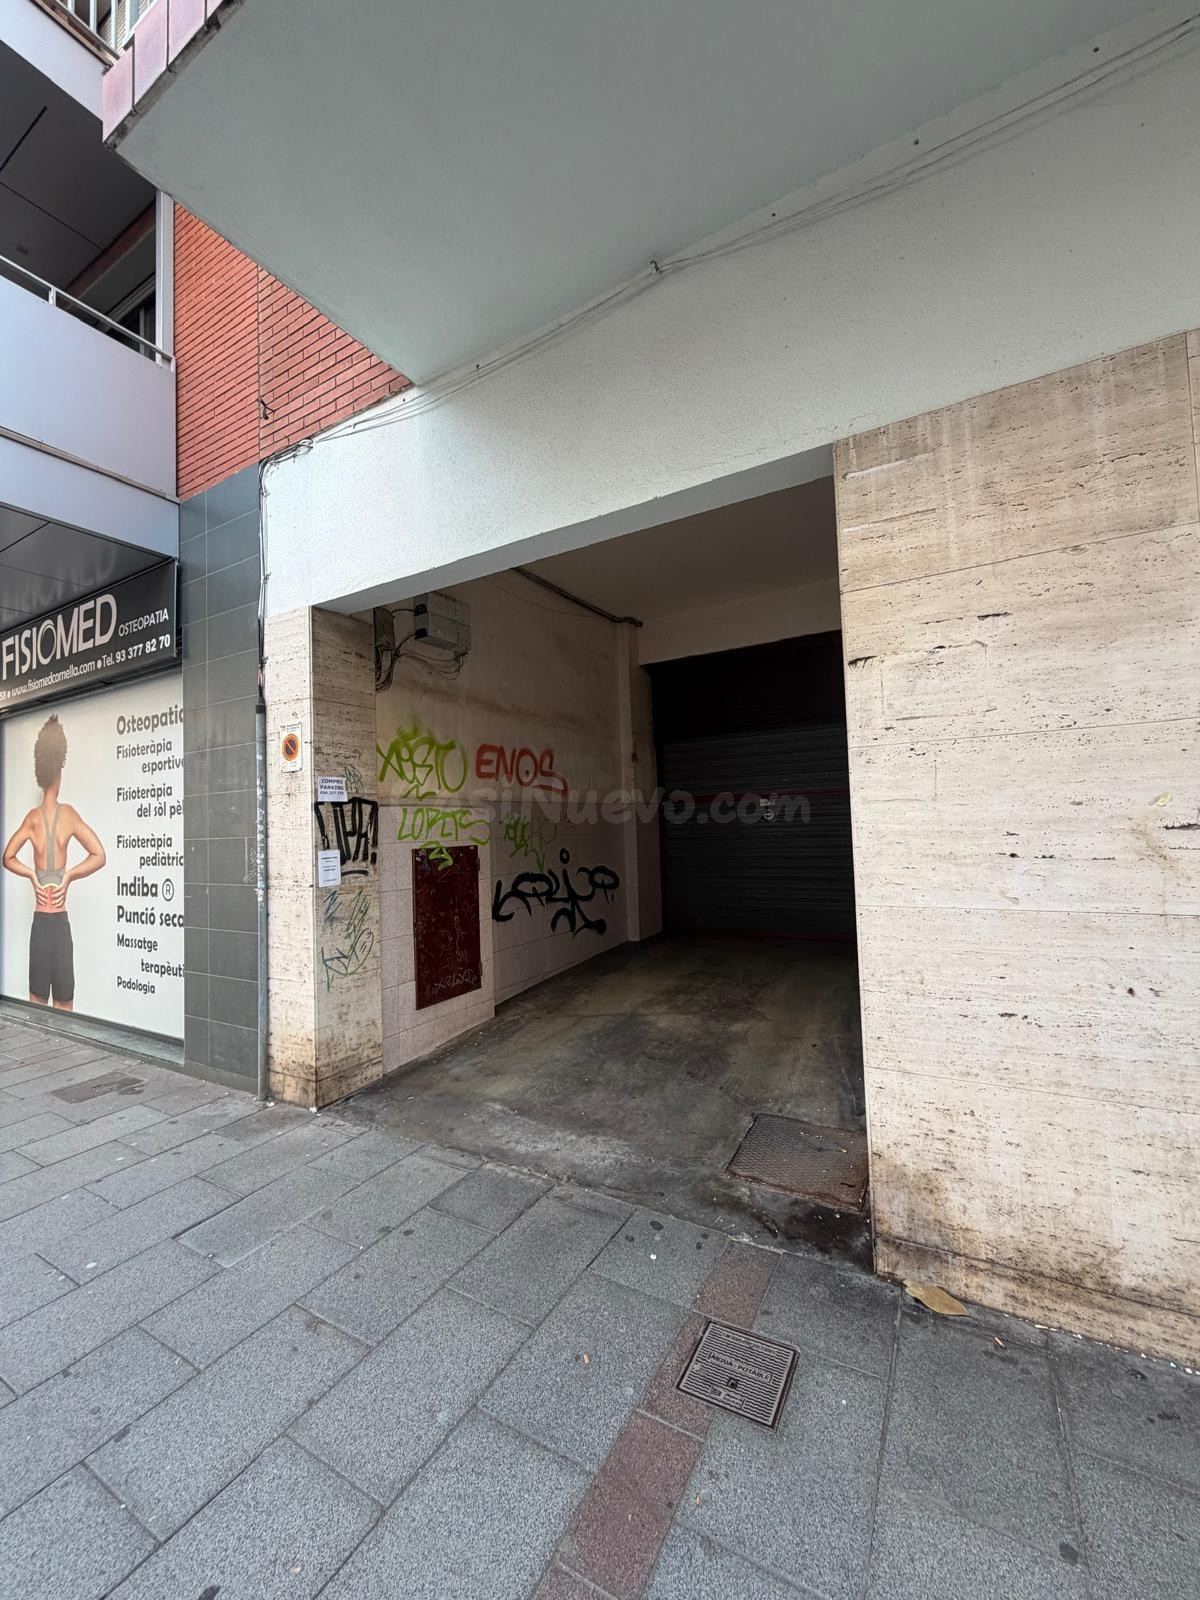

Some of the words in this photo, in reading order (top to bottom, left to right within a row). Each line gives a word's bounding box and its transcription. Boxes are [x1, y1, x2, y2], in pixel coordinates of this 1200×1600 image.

[2, 594, 117, 681] FISIOMED
[118, 608, 169, 637] OSTEOPATIA
[12, 660, 95, 697] www.fisiomedcornella.com
[102, 655, 115, 667] Tel.
[115, 651, 126, 663] 93
[128, 644, 143, 660] 377
[145, 638, 157, 653] 82
[159, 634, 171, 649] 70
[116, 738, 172, 759] Fisioteràpia
[141, 755, 184, 775] esportiv
[475, 743, 568, 799] ENOS
[116, 783, 172, 802] Fisioteràpia
[137, 803, 151, 818] del
[154, 801, 167, 817] sòl
[169, 800, 184, 819] pè
[116, 834, 172, 851] Fisioteràpia
[117, 876, 158, 898] Indiba
[117, 905, 156, 926] Punció
[117, 933, 158, 953] Massatge
[117, 976, 155, 995] Podologia
[711, 1353, 733, 1367] AIGUA
[737, 1365, 771, 1381] POTABLE
